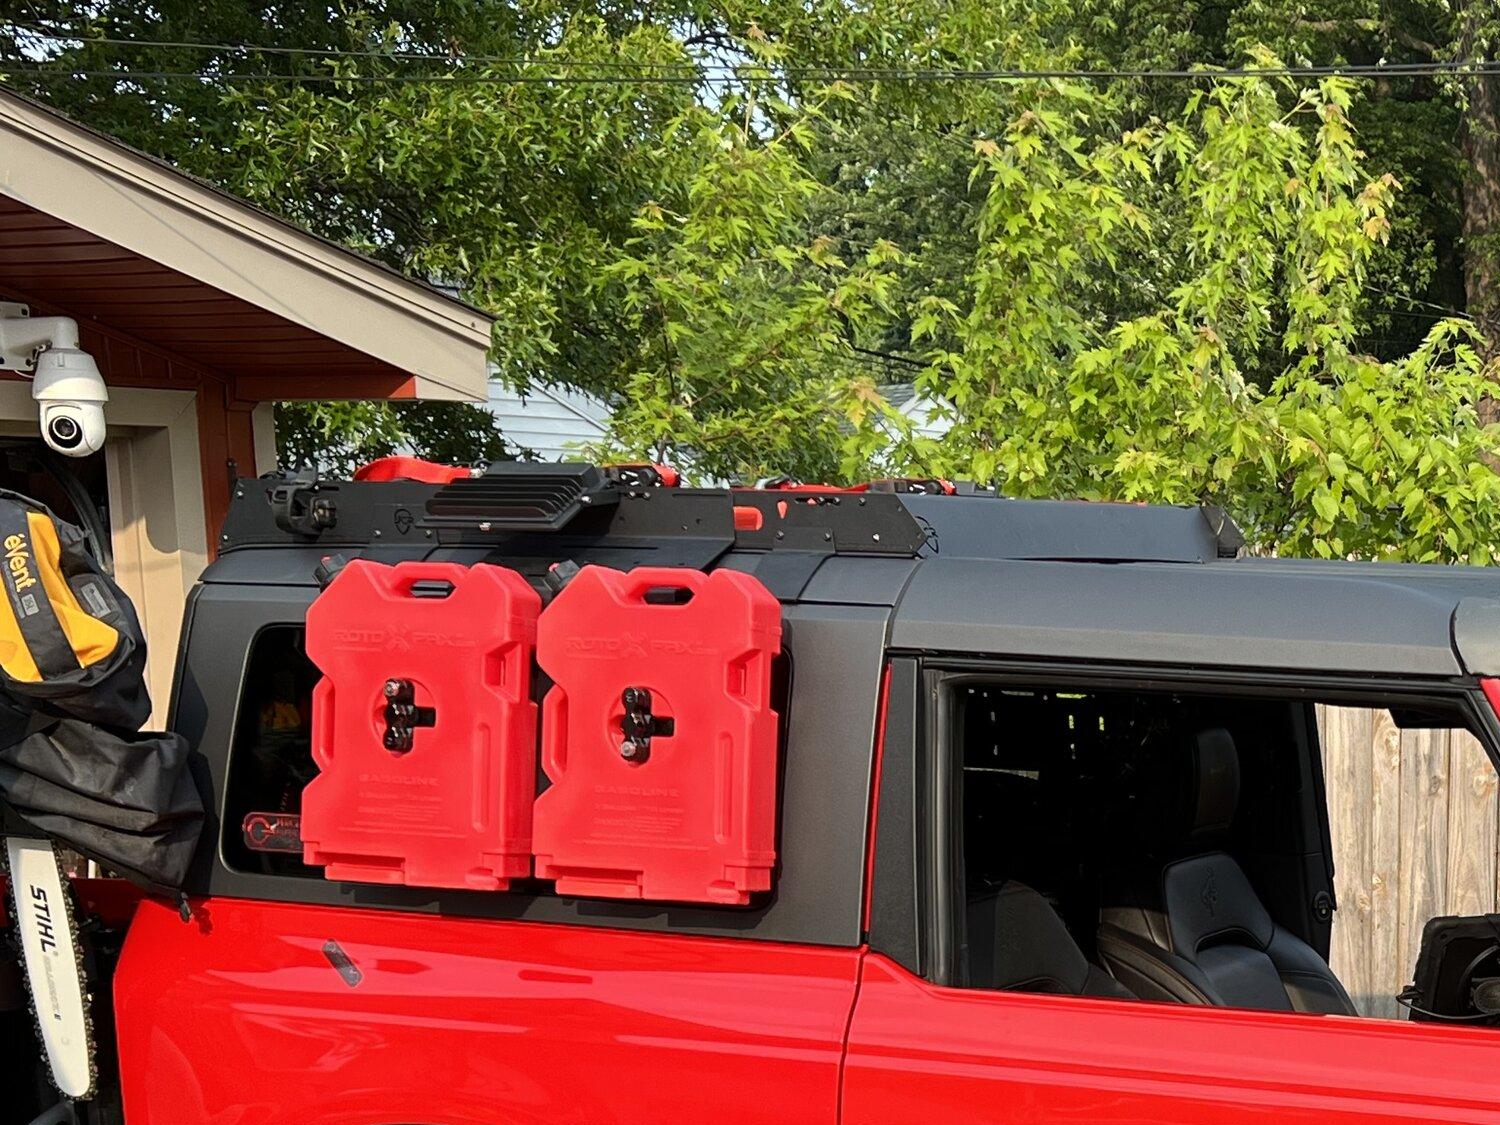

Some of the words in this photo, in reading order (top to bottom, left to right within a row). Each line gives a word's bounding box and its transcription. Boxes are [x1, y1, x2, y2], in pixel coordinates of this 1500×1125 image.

[359, 774, 440, 787] GASOLINE
[595, 785, 681, 798] GASOLINE
[30, 884, 57, 953] STIHL
